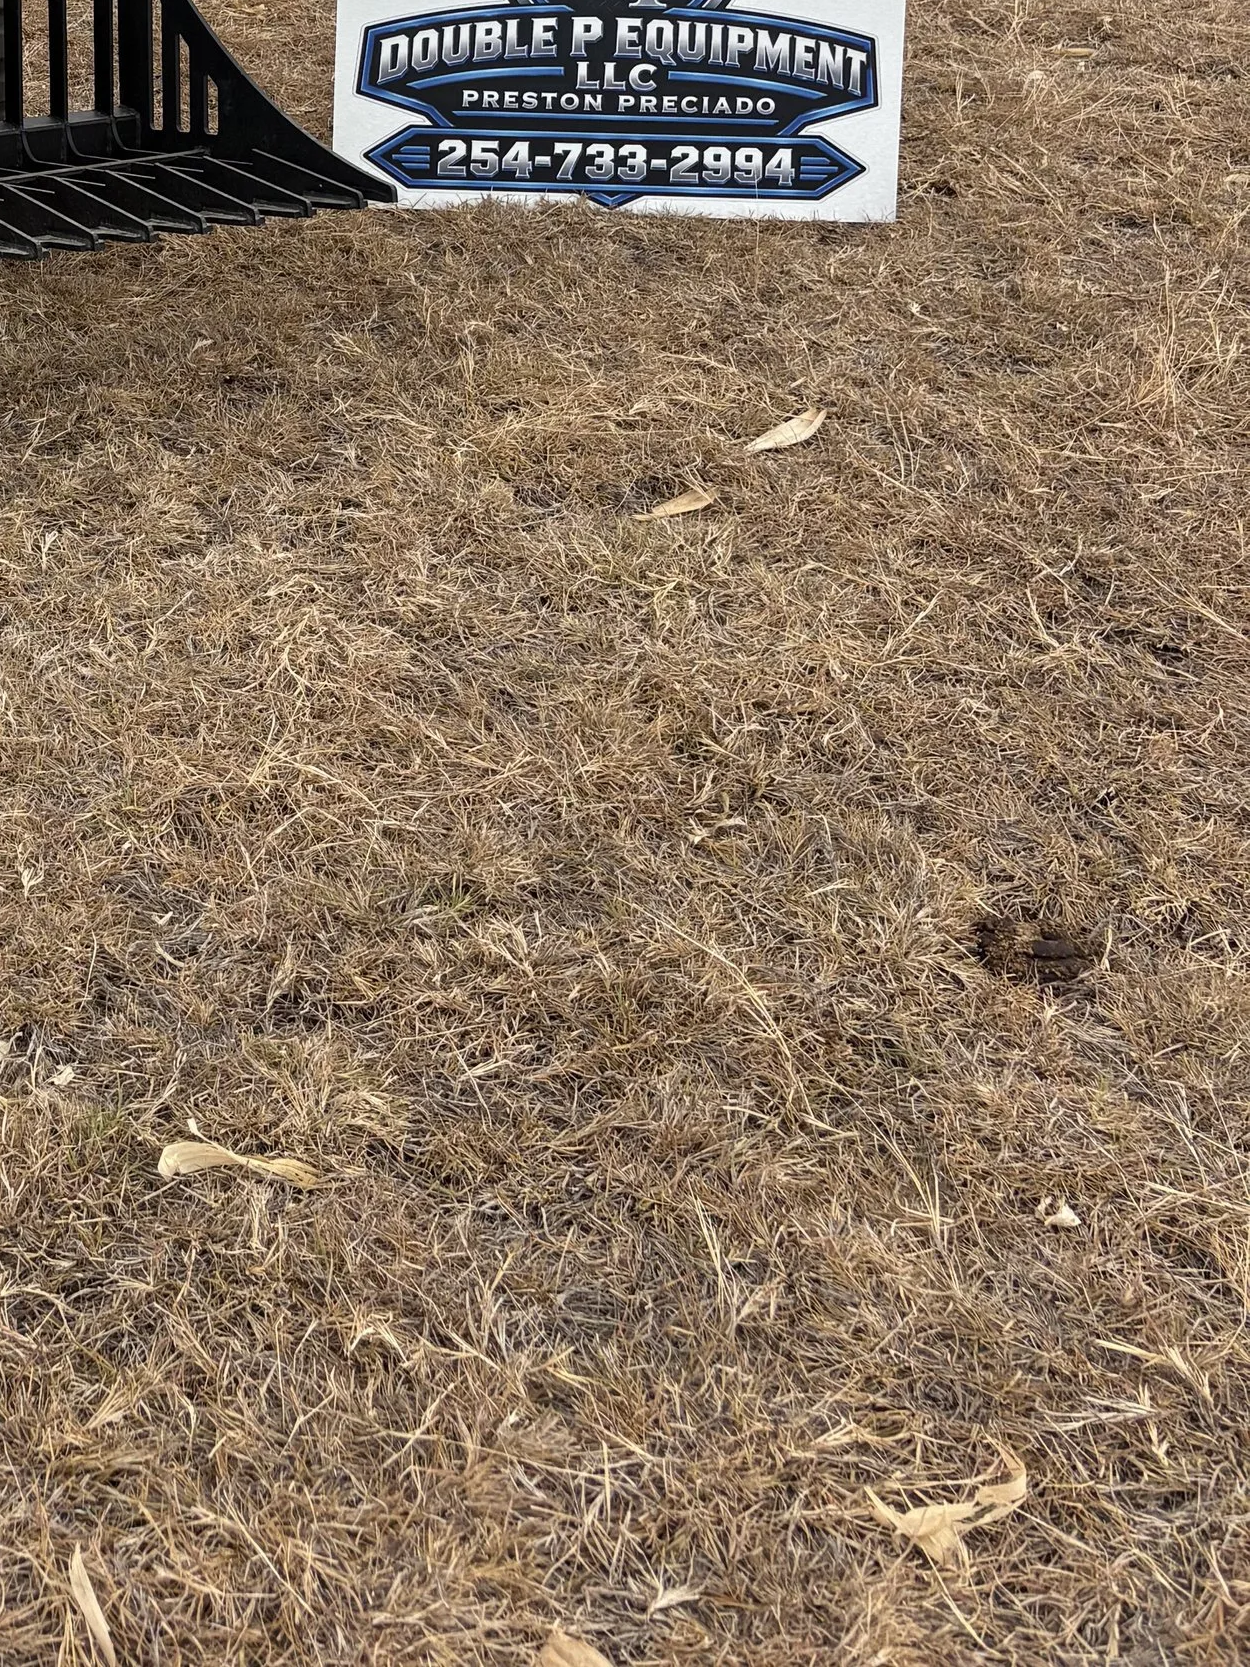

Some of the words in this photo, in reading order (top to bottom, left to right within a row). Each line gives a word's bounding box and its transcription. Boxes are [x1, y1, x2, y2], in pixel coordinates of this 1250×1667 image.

[377, 16, 559, 85] DOUBLE
[569, 15, 604, 58] P
[613, 16, 868, 98] EQUIPMENT
[575, 61, 658, 92] LLC
[461, 89, 603, 112] PRESTON
[617, 94, 776, 115] PRECIADO
[436, 138, 796, 187] 254-733-2994
